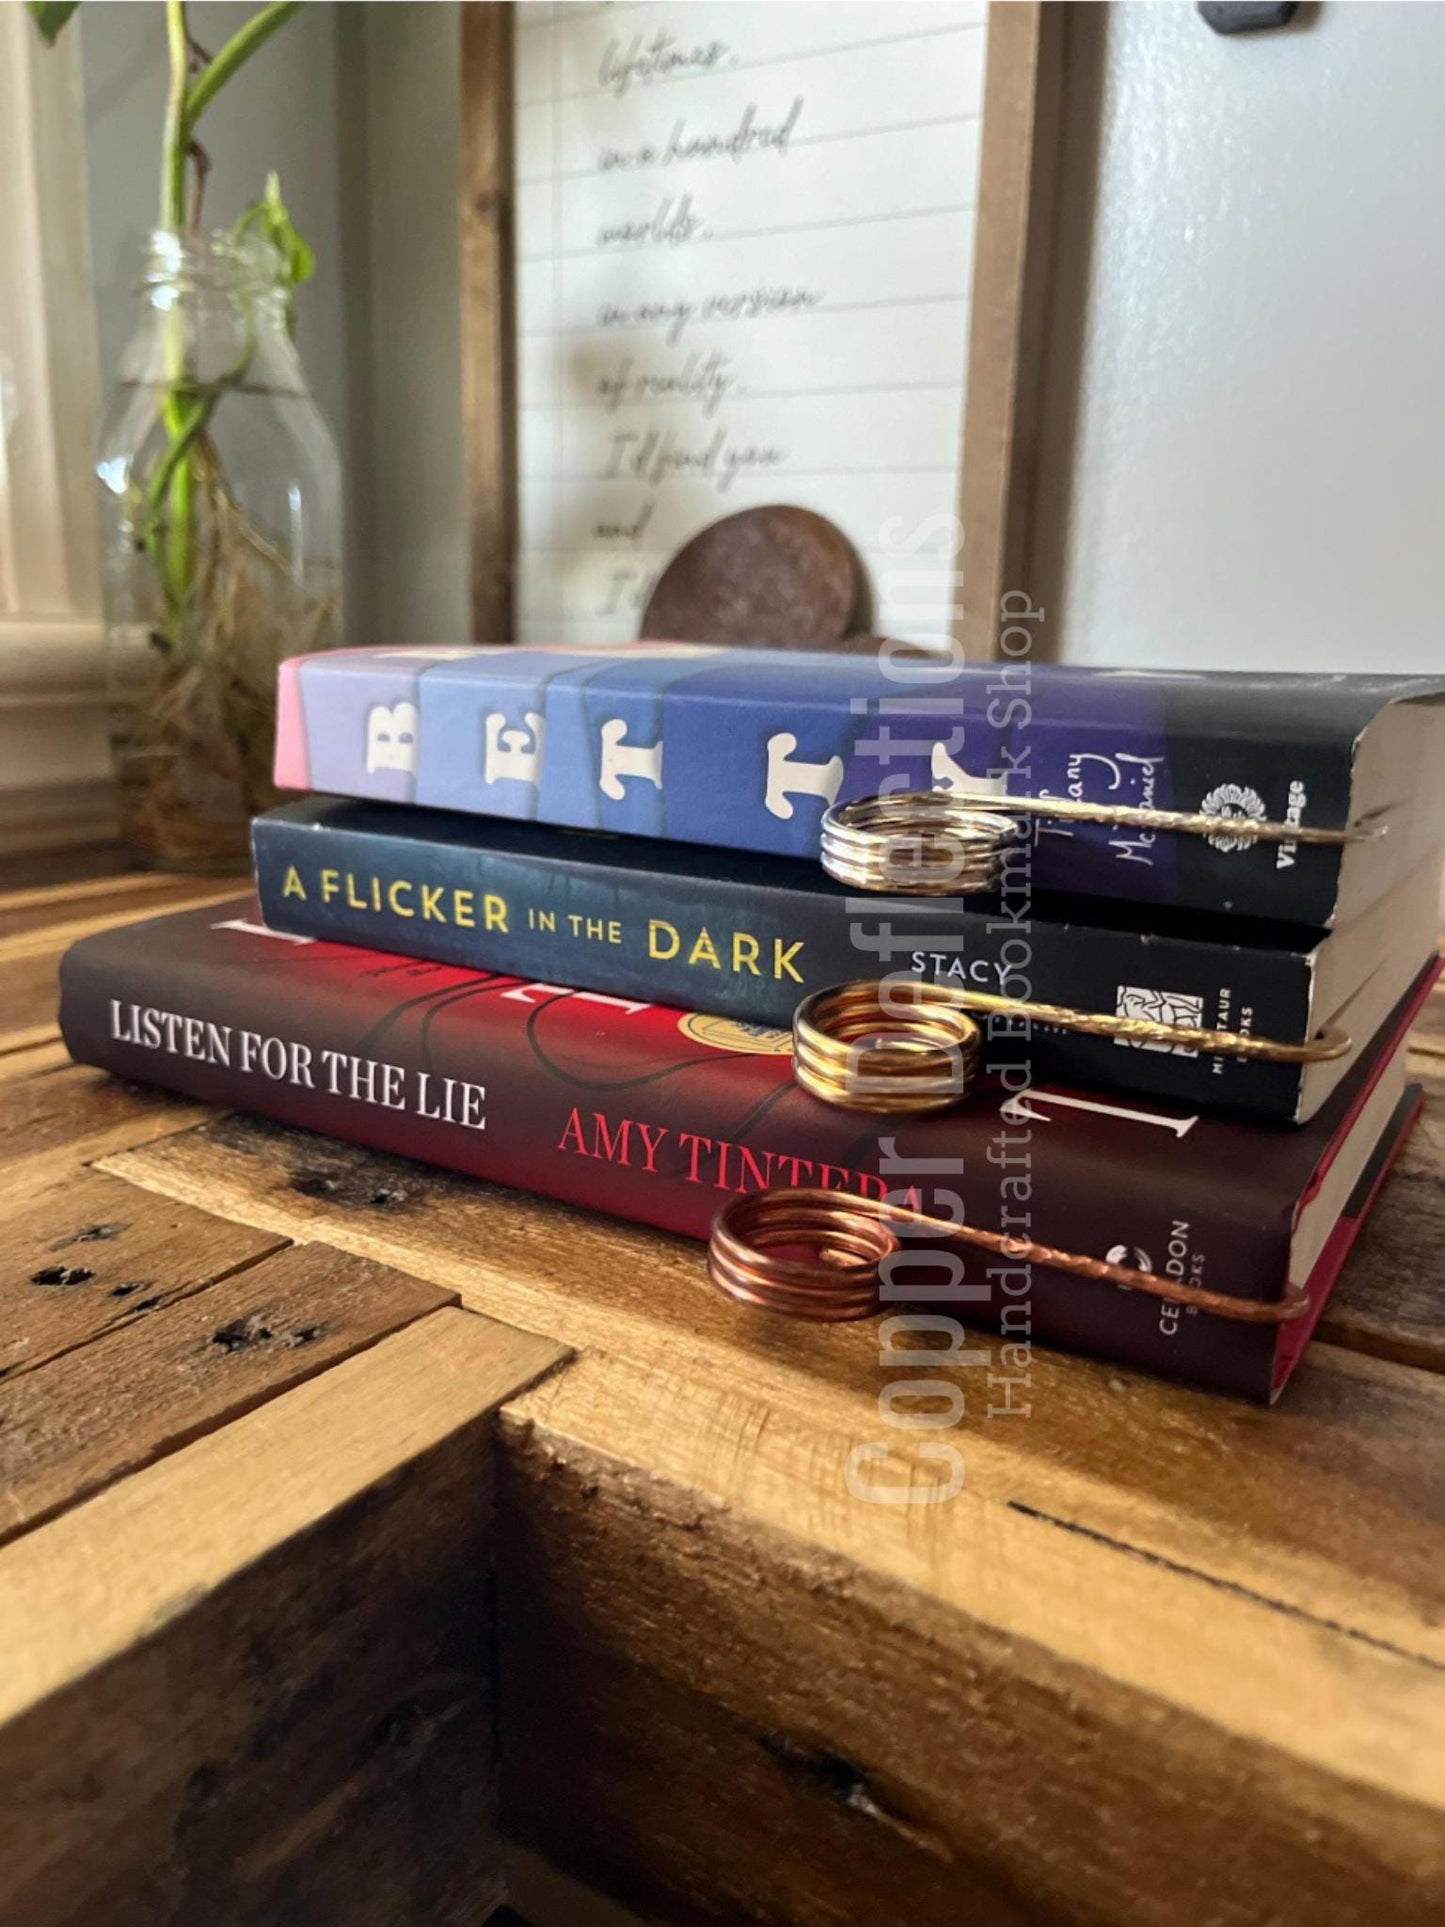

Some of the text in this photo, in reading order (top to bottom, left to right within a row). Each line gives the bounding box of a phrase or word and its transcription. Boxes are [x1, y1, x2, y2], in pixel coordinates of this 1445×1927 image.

[659, 97, 804, 166] hundred
[1034, 753, 1121, 848] Tifany
[1108, 753, 1165, 867] Mcaniel
[282, 866, 307, 900] A
[321, 868, 510, 933] FLICKER
[528, 908, 555, 933] IN
[569, 914, 623, 945] THE
[647, 919, 806, 984] DARK
[911, 950, 1012, 986] STACY
[110, 1000, 487, 1131] LISTEN FOR THE LIE
[1212, 988, 1231, 1075] MITAUR
[557, 1107, 669, 1173] AMY
[1159, 1220, 1190, 1336] CELDON
